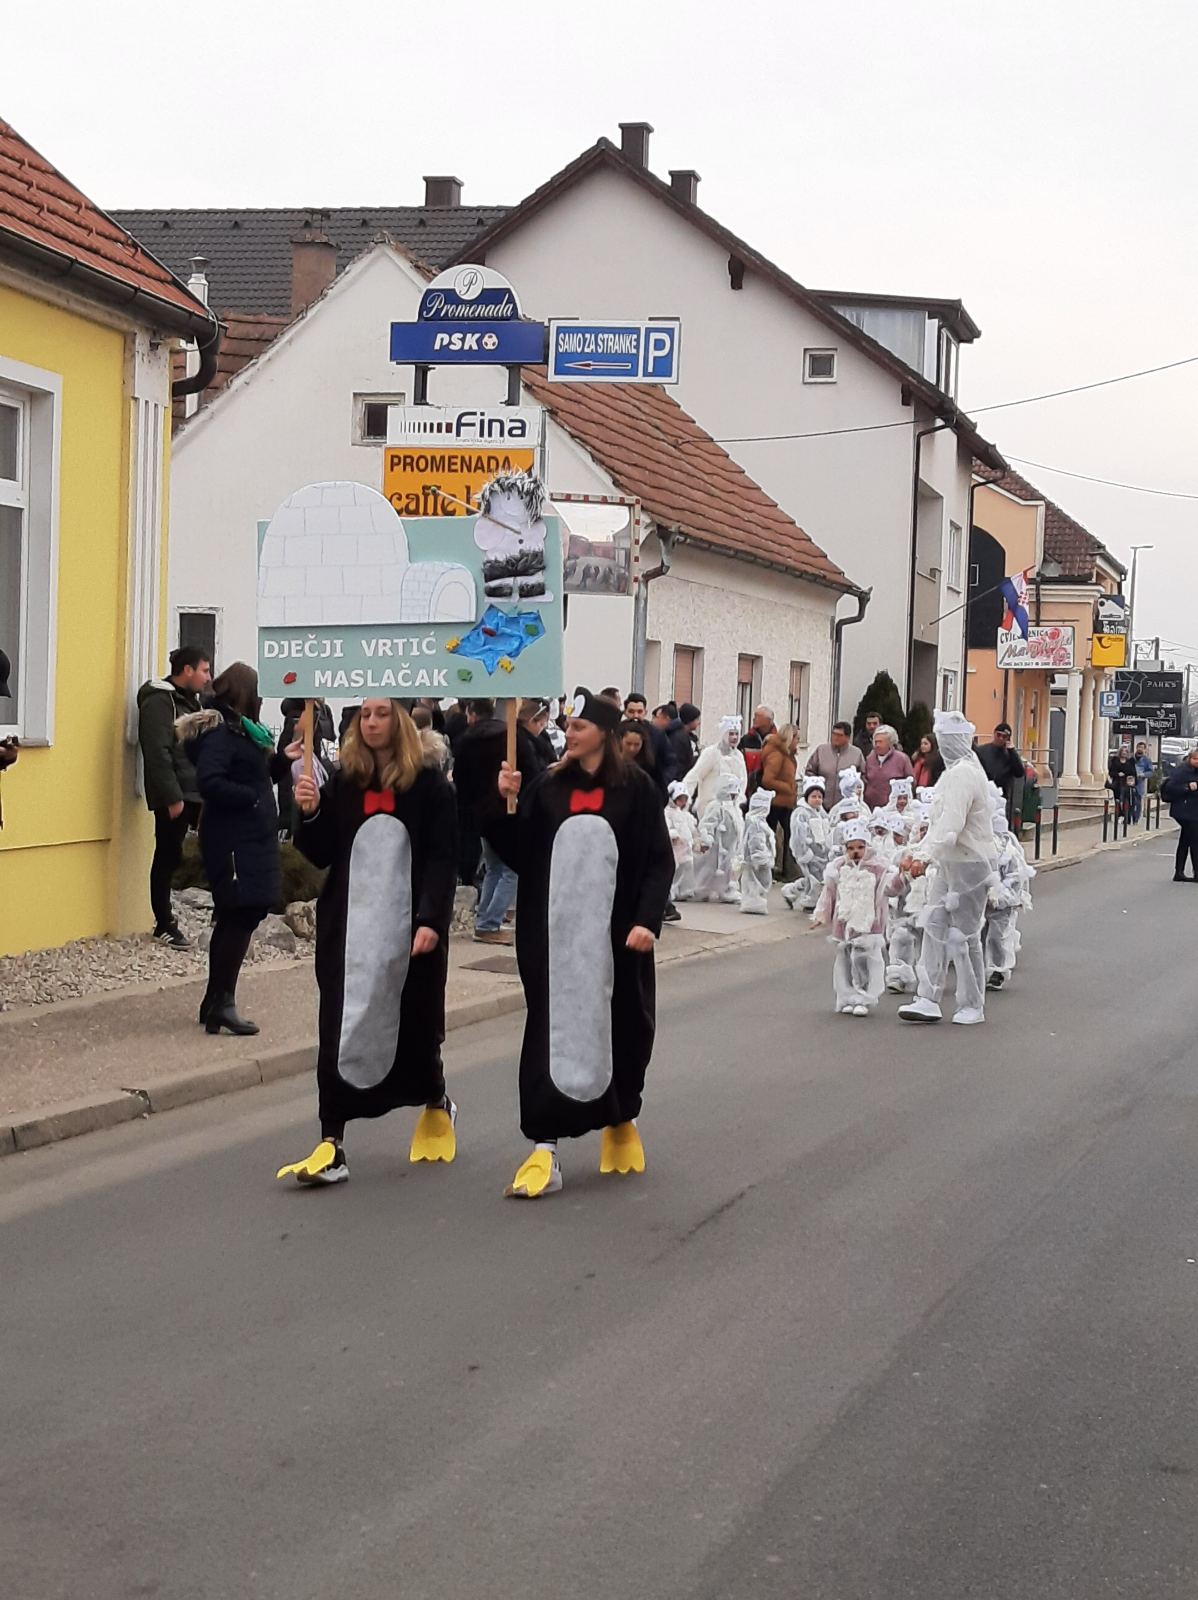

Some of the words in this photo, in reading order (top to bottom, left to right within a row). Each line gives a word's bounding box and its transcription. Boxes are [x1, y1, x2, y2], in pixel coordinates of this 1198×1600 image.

[423, 292, 514, 318] Promenada
[434, 332, 481, 351] PSK
[558, 332, 584, 354] SAMO
[584, 333, 596, 353] ZA
[597, 332, 638, 354] STRANKE
[647, 332, 671, 373] P
[455, 409, 527, 438] Fina
[389, 454, 512, 473] PROMENADA
[263, 634, 344, 659] DJEČJI
[361, 631, 437, 657] VRTIĆ
[314, 663, 449, 689] MASLAČAK
